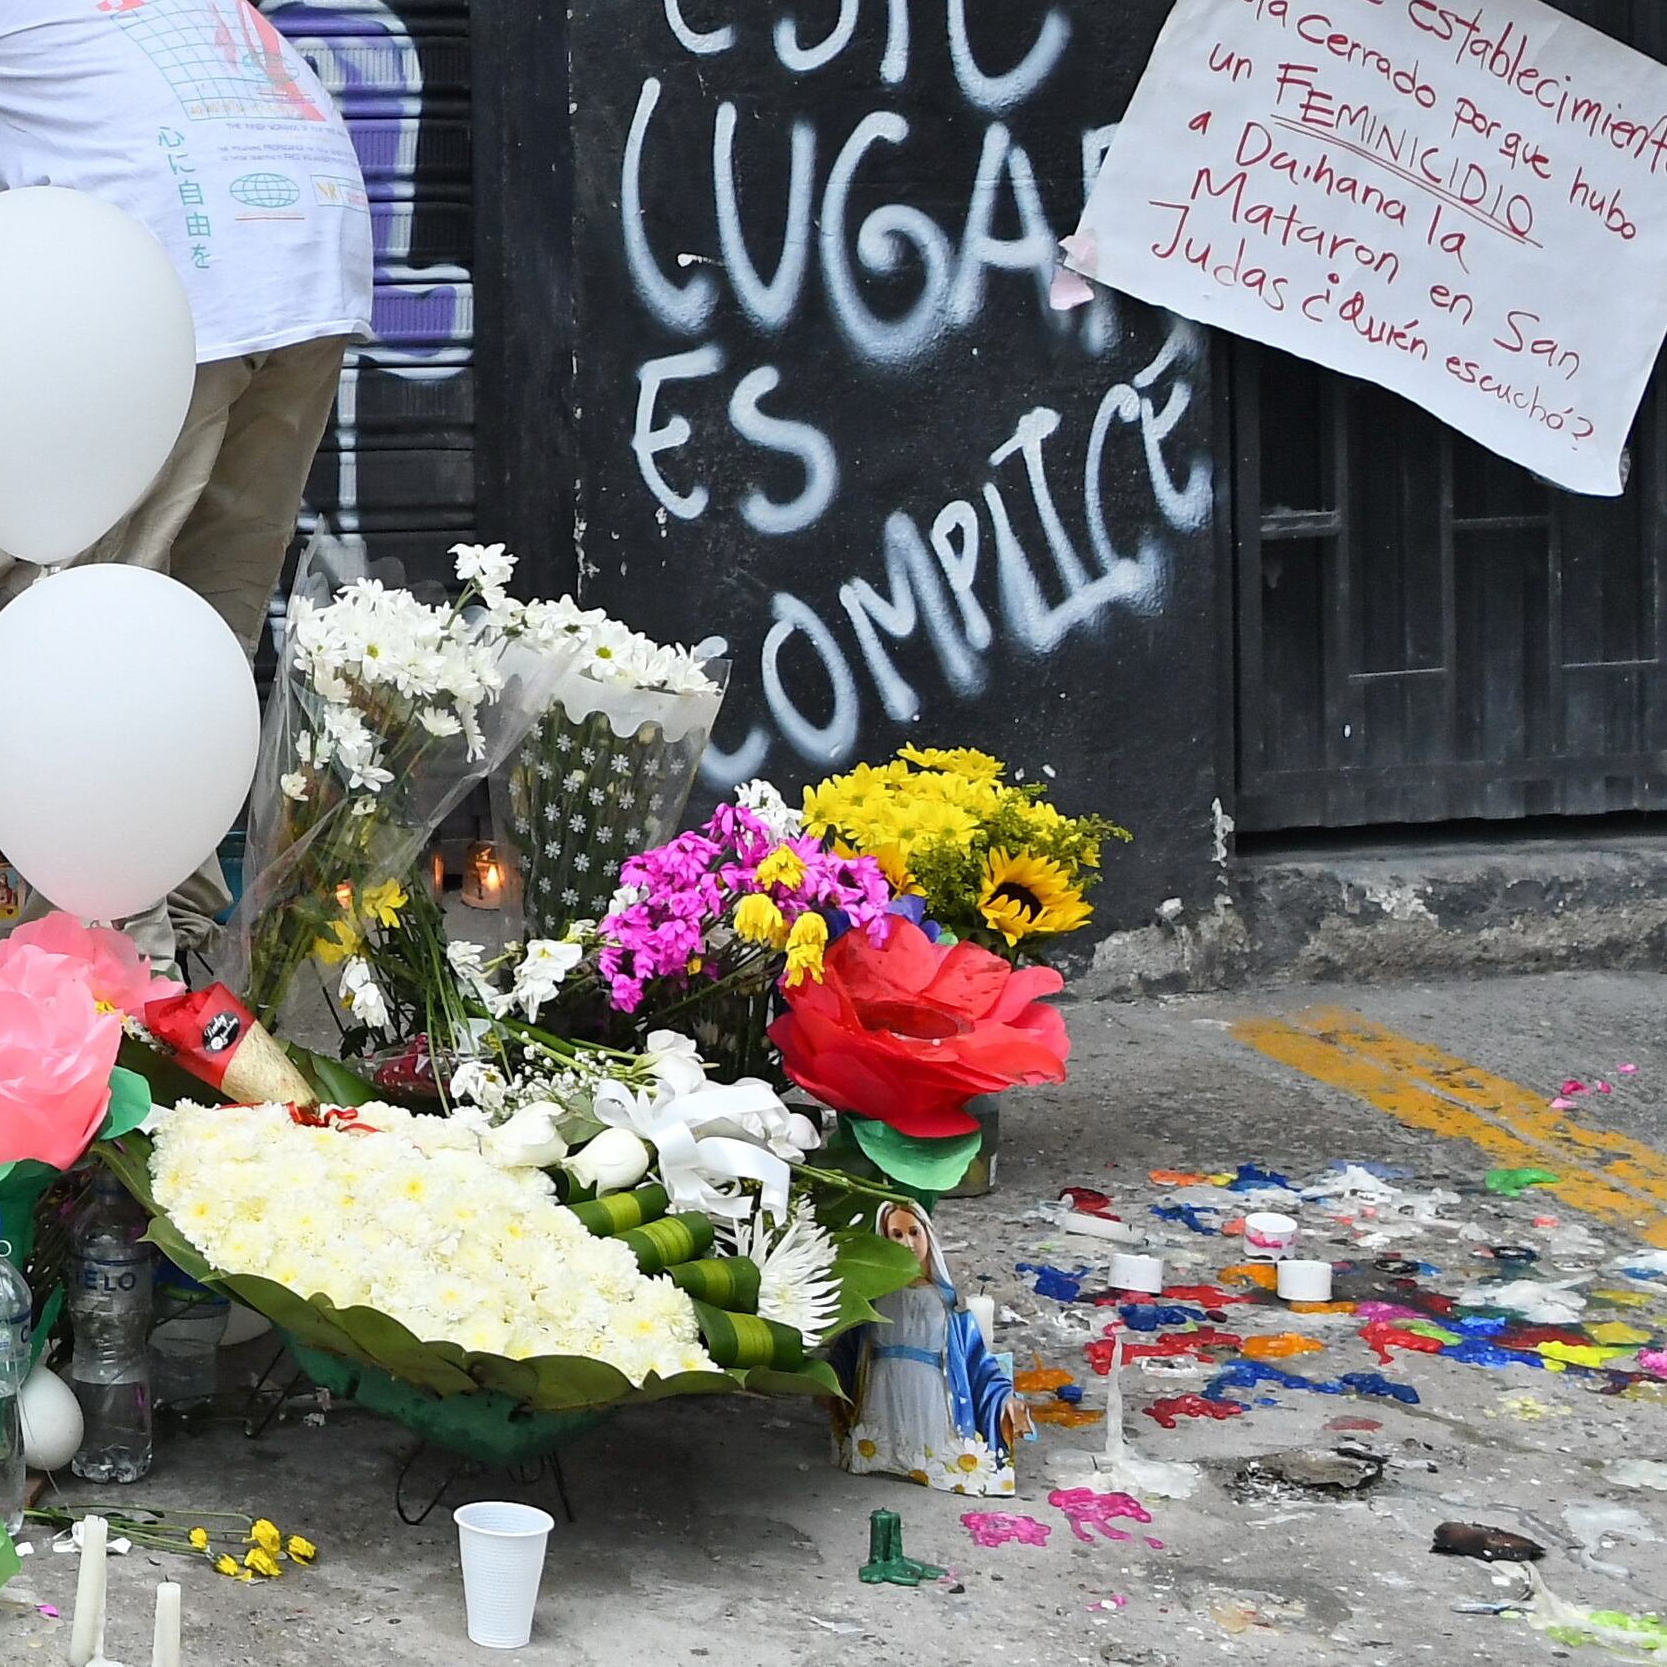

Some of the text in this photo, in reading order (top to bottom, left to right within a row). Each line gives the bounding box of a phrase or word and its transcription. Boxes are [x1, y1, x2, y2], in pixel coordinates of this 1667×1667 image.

[1208, 42, 1535, 237] un FEMINICIDIO
[1568, 165, 1637, 240] hubo
[1148, 199, 1289, 313] Judas
[1190, 167, 1581, 381] Mataron en San
[1427, 205, 1471, 274] la
[629, 344, 841, 534] ES
